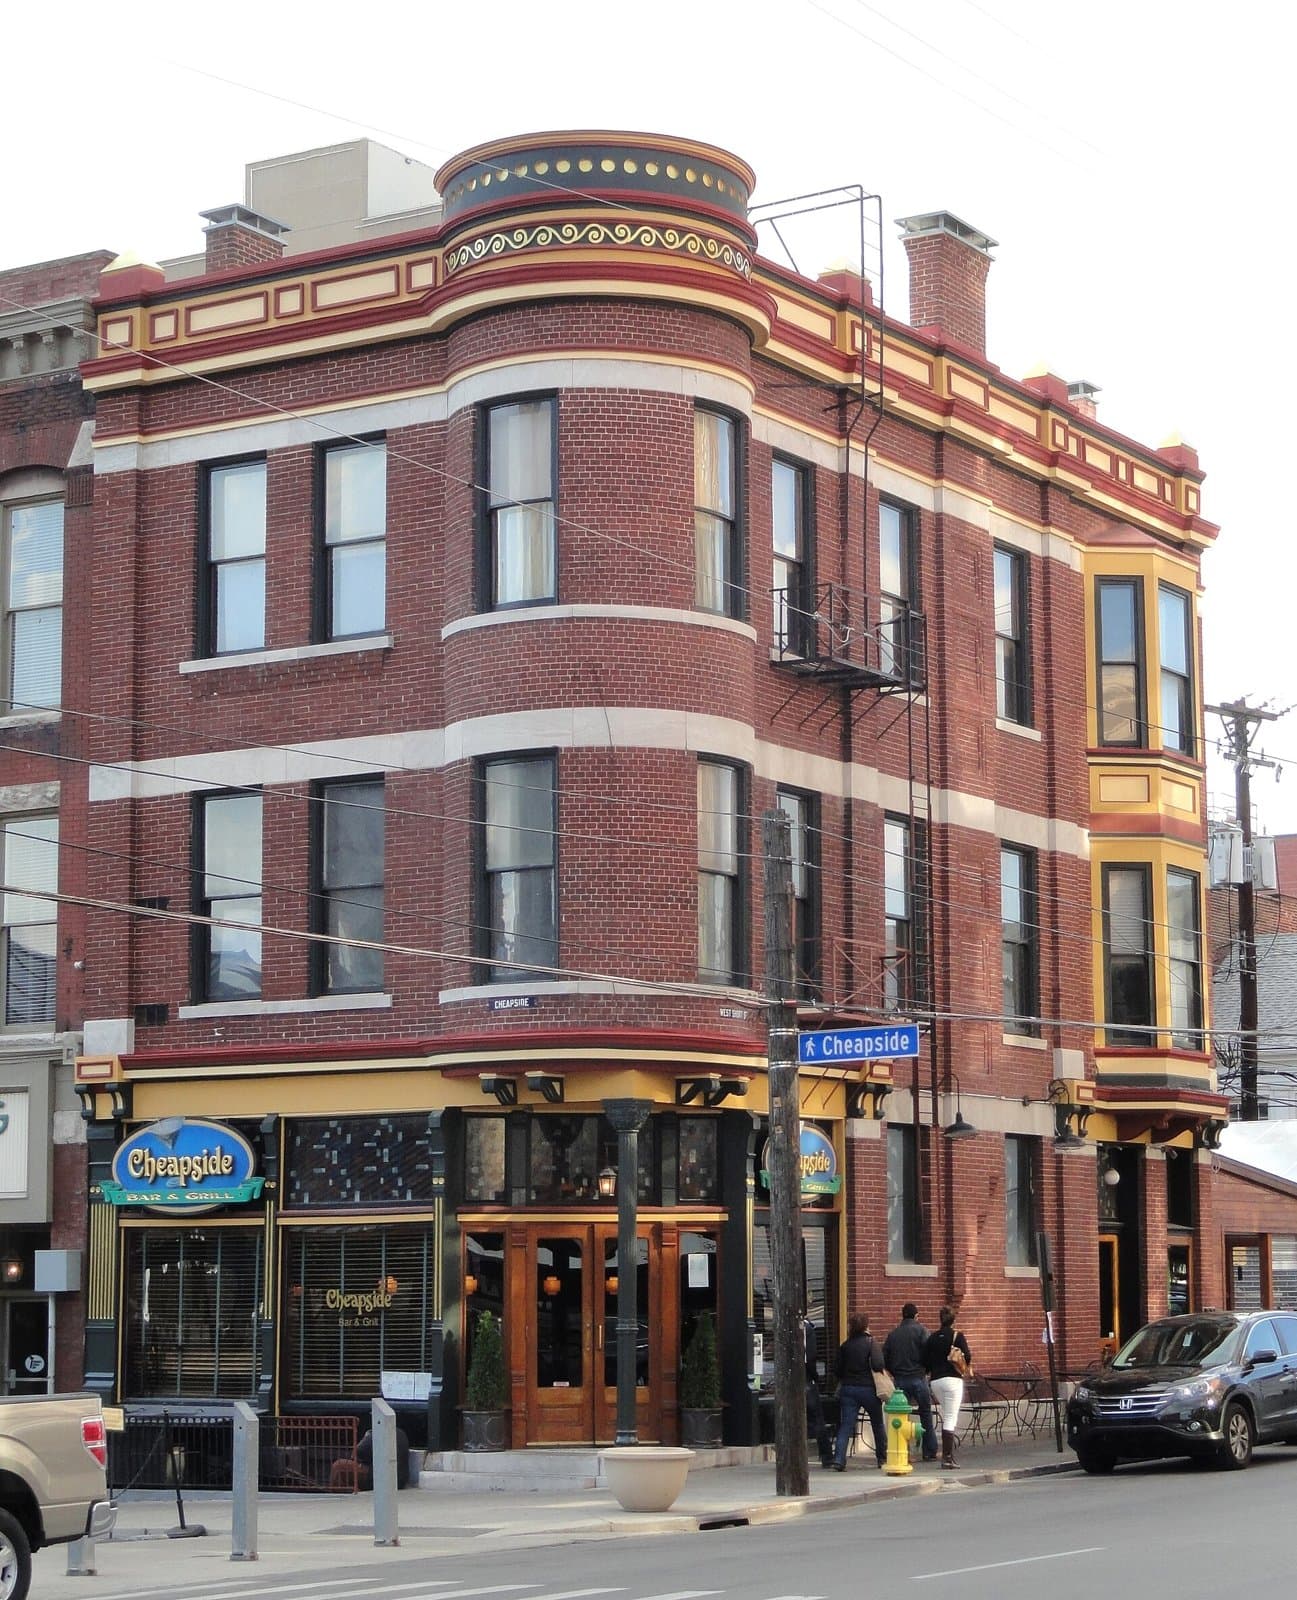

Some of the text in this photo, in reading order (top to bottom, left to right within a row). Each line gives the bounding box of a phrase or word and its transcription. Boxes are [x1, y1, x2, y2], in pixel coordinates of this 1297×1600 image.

[494, 998, 530, 1009] CHEAPSIDE
[822, 1031, 909, 1057] Cheapside
[127, 1145, 234, 1187] Cheapside
[126, 1191, 234, 1201] BAR & GRILL
[326, 1288, 392, 1315] Cheapside
[338, 1317, 353, 1327] Bar
